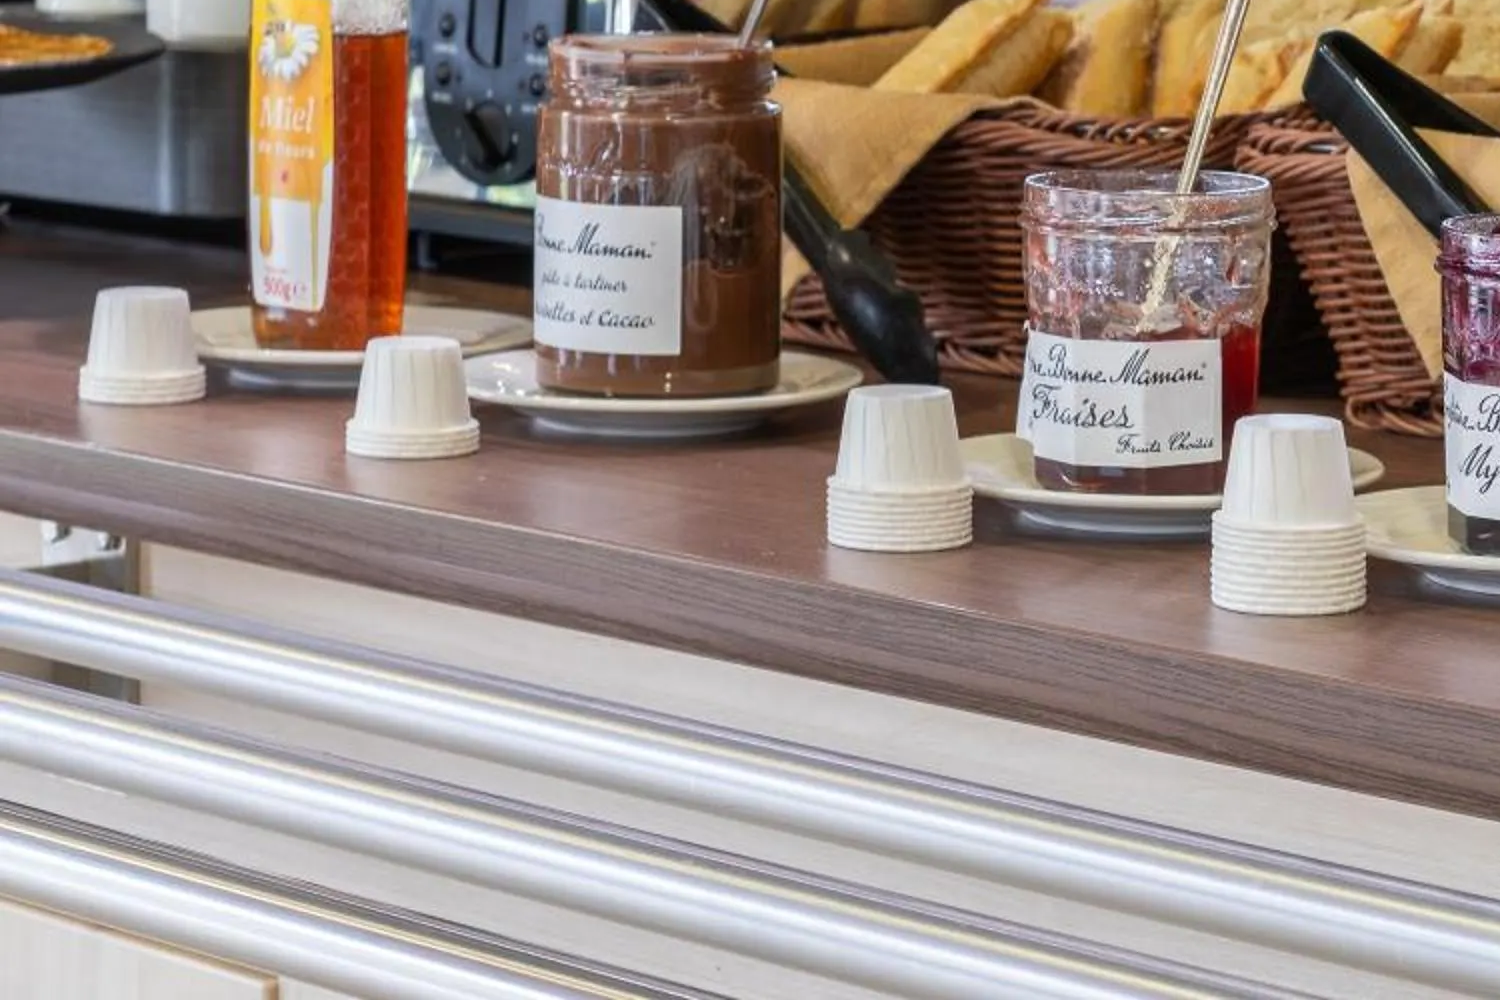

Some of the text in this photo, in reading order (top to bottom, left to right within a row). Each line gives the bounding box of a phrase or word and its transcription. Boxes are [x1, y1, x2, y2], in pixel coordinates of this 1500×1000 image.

[259, 95, 315, 134] Miel
[574, 271, 627, 293] tartiner
[597, 310, 655, 329] Cacao
[1047, 344, 1106, 383] Bonne
[1032, 383, 1134, 429] Fraises
[1115, 433, 1161, 454] Fruits
